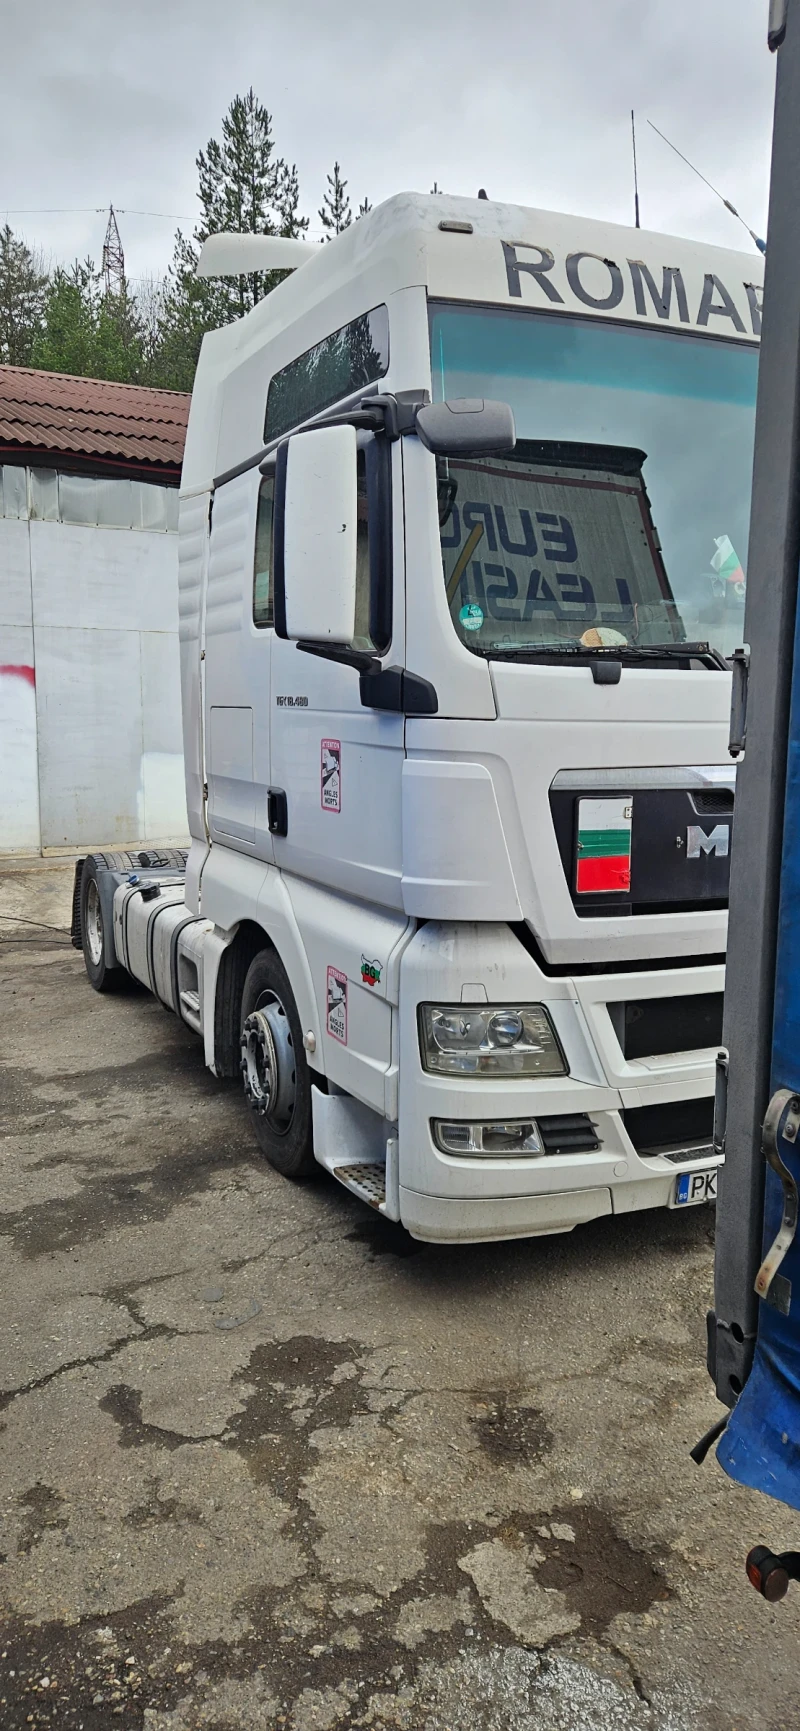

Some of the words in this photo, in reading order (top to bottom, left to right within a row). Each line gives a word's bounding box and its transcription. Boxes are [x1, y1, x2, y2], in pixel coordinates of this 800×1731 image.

[324, 789, 338, 798] ANGLES
[325, 797, 338, 806] MORTS
[328, 969, 346, 982] ATTENTION
[364, 963, 376, 978] BG
[329, 1016, 345, 1030] ANGLES
[330, 1023, 344, 1038] MORTS
[691, 1173, 717, 1198] PK
